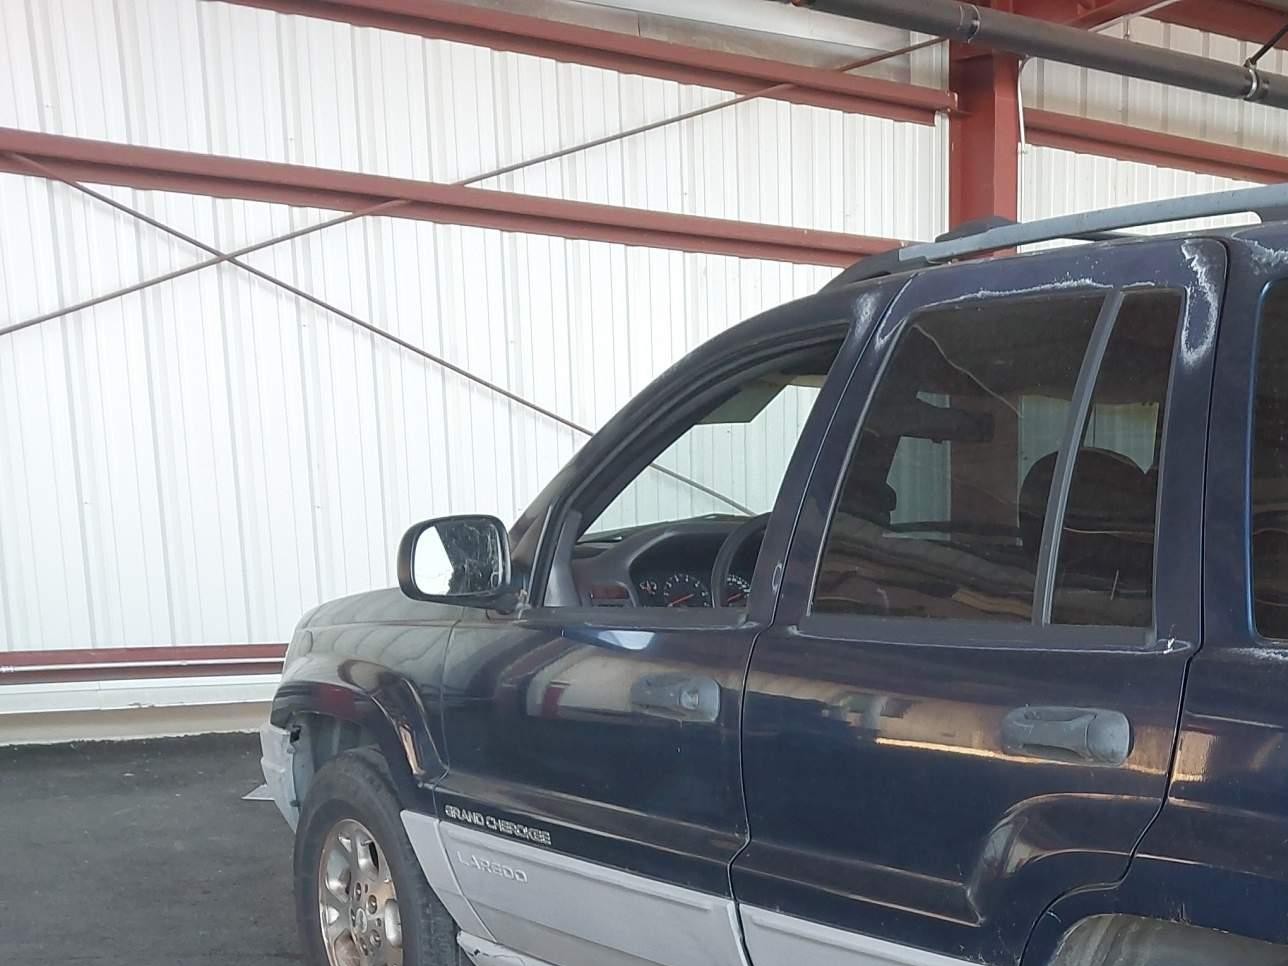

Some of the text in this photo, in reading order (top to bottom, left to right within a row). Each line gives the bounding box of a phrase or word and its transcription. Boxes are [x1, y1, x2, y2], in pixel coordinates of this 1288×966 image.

[445, 804, 552, 845] GRAND CHEROKEE
[457, 850, 529, 883] LAREDO
